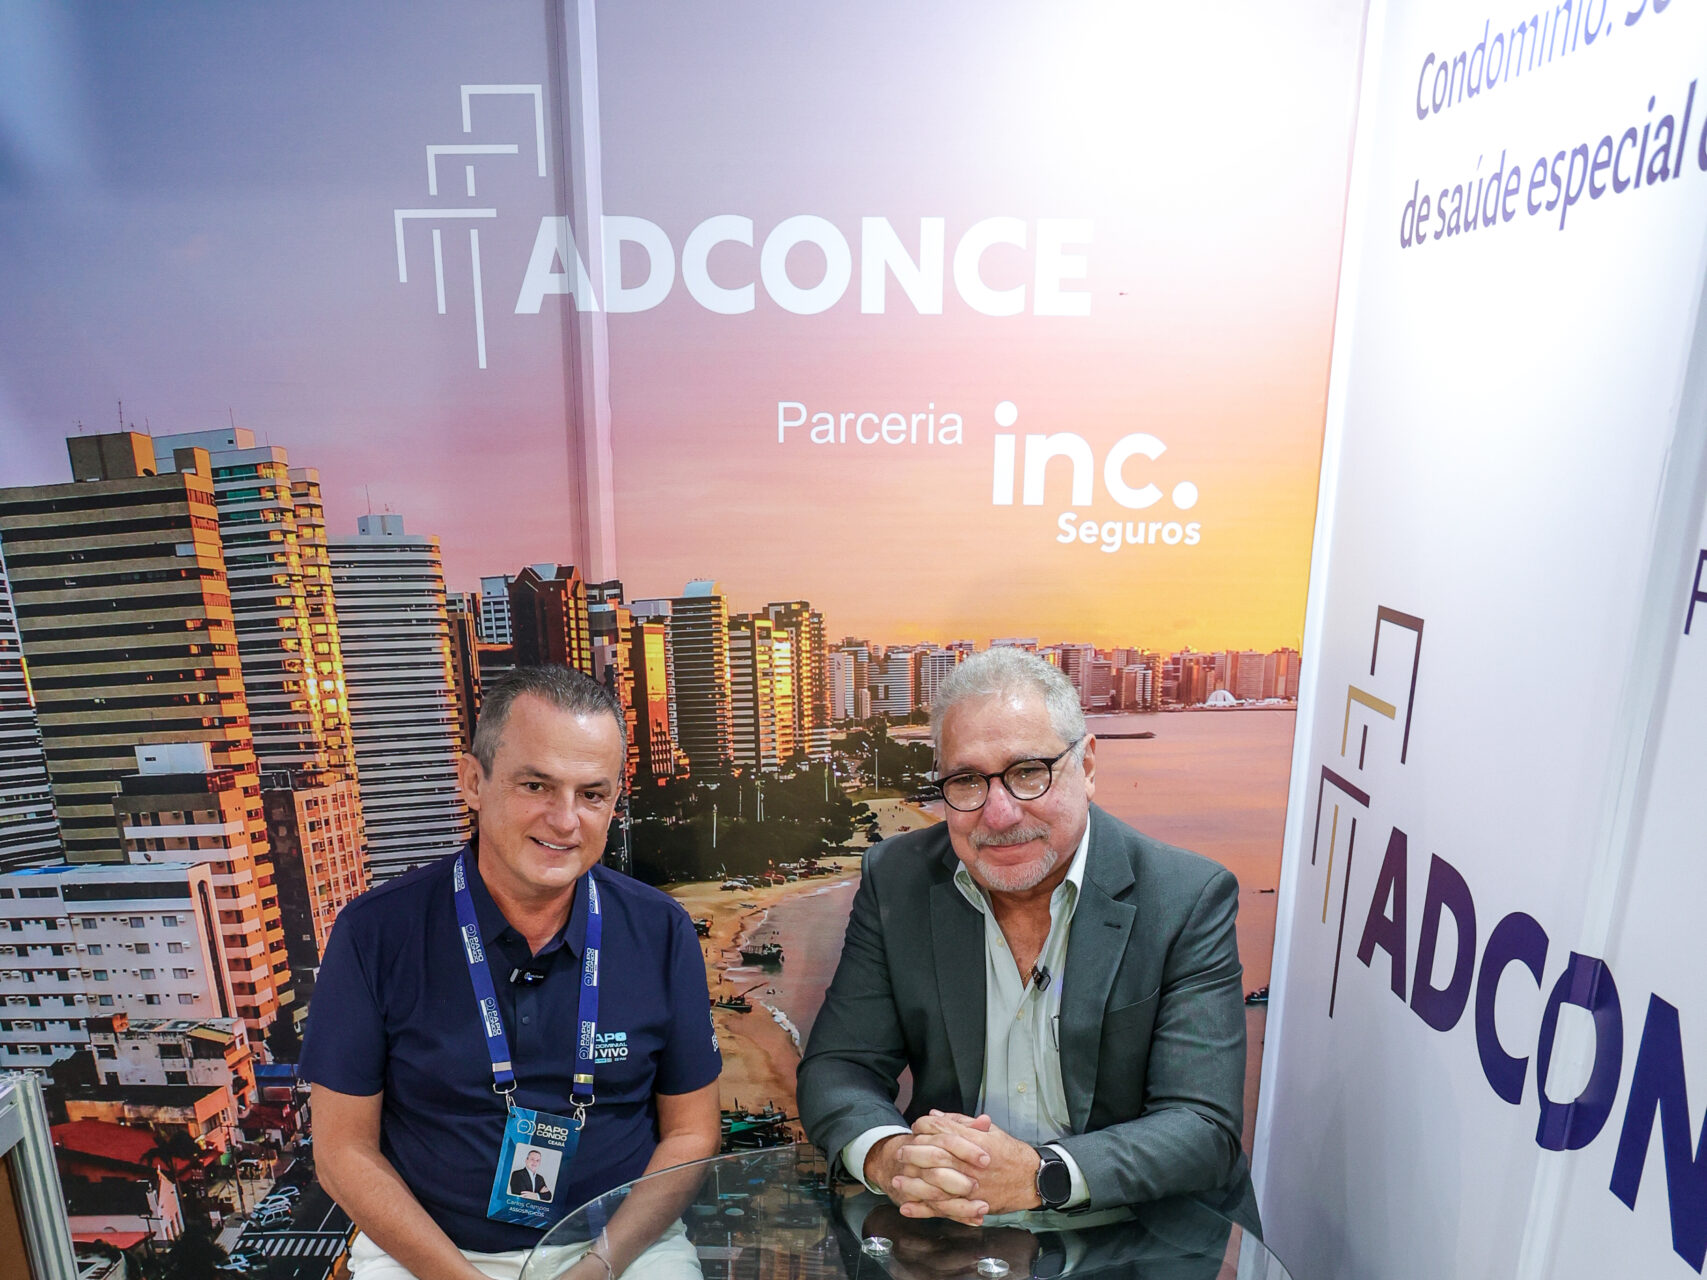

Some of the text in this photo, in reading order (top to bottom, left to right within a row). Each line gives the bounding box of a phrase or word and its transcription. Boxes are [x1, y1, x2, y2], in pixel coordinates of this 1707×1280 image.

[1400, 178, 1431, 249] de
[1433, 149, 1521, 241] saúde
[1527, 78, 1698, 231] especial
[514, 214, 1095, 317] ADCONCE
[777, 401, 964, 445] Parceria
[993, 400, 1199, 510] inc.
[1055, 511, 1201, 553] Seguros
[473, 936, 484, 962] PAPO
[491, 1010, 502, 1036] PAPO
[595, 1032, 627, 1043] APO
[599, 1047, 629, 1058] VIVO
[536, 1130, 568, 1142] CONDO
[537, 1123, 569, 1136] PAPO
[506, 1199, 525, 1209] Carlos
